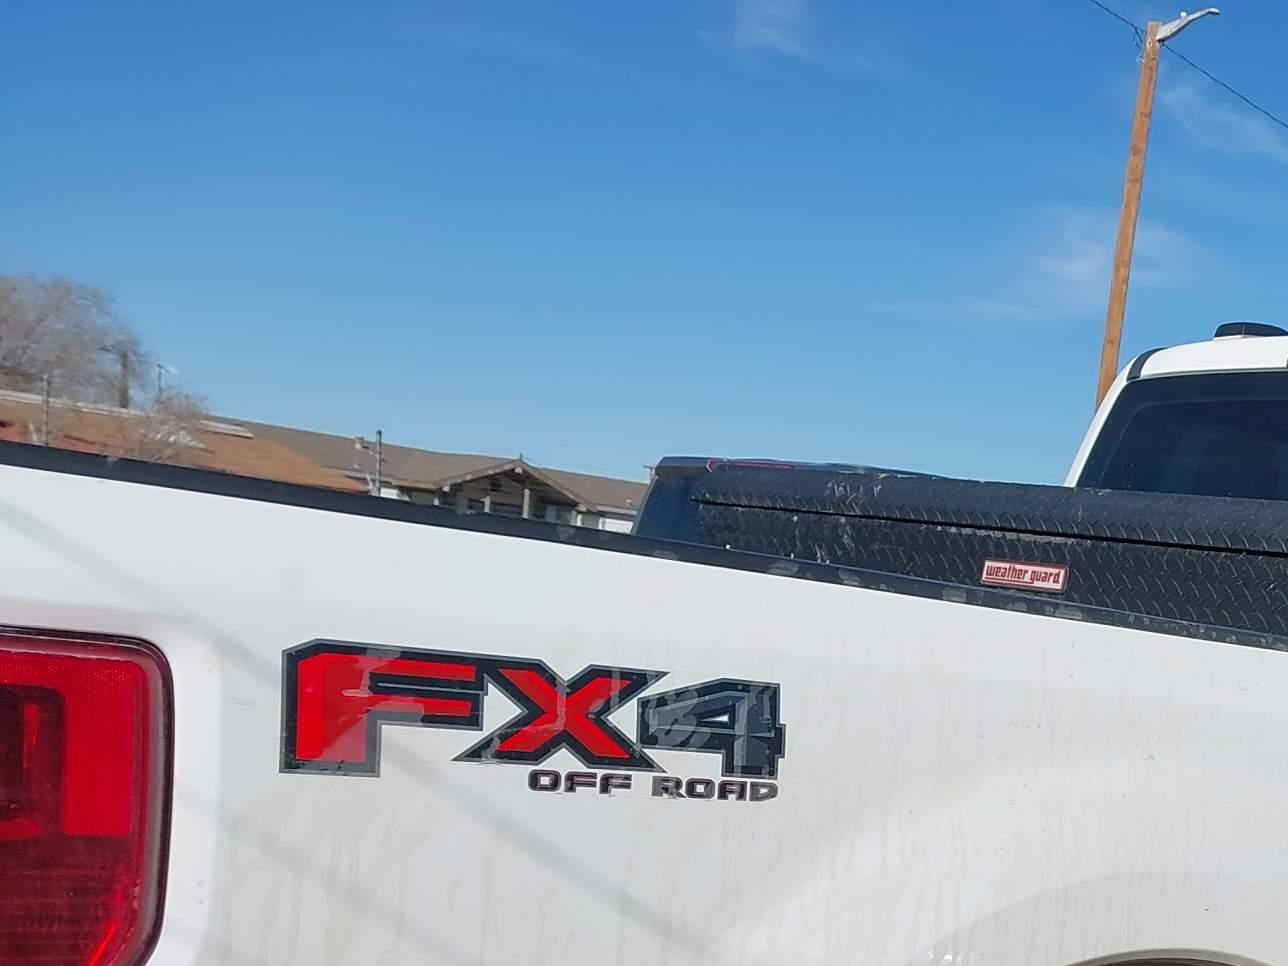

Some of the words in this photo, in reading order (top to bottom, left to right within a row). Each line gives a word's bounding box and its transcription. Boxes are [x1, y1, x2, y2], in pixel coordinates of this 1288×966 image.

[985, 564, 1030, 580] weather
[1030, 569, 1060, 585] guard
[279, 637, 786, 778] FX4
[527, 768, 632, 796] OFF
[651, 774, 779, 801] ROAD
